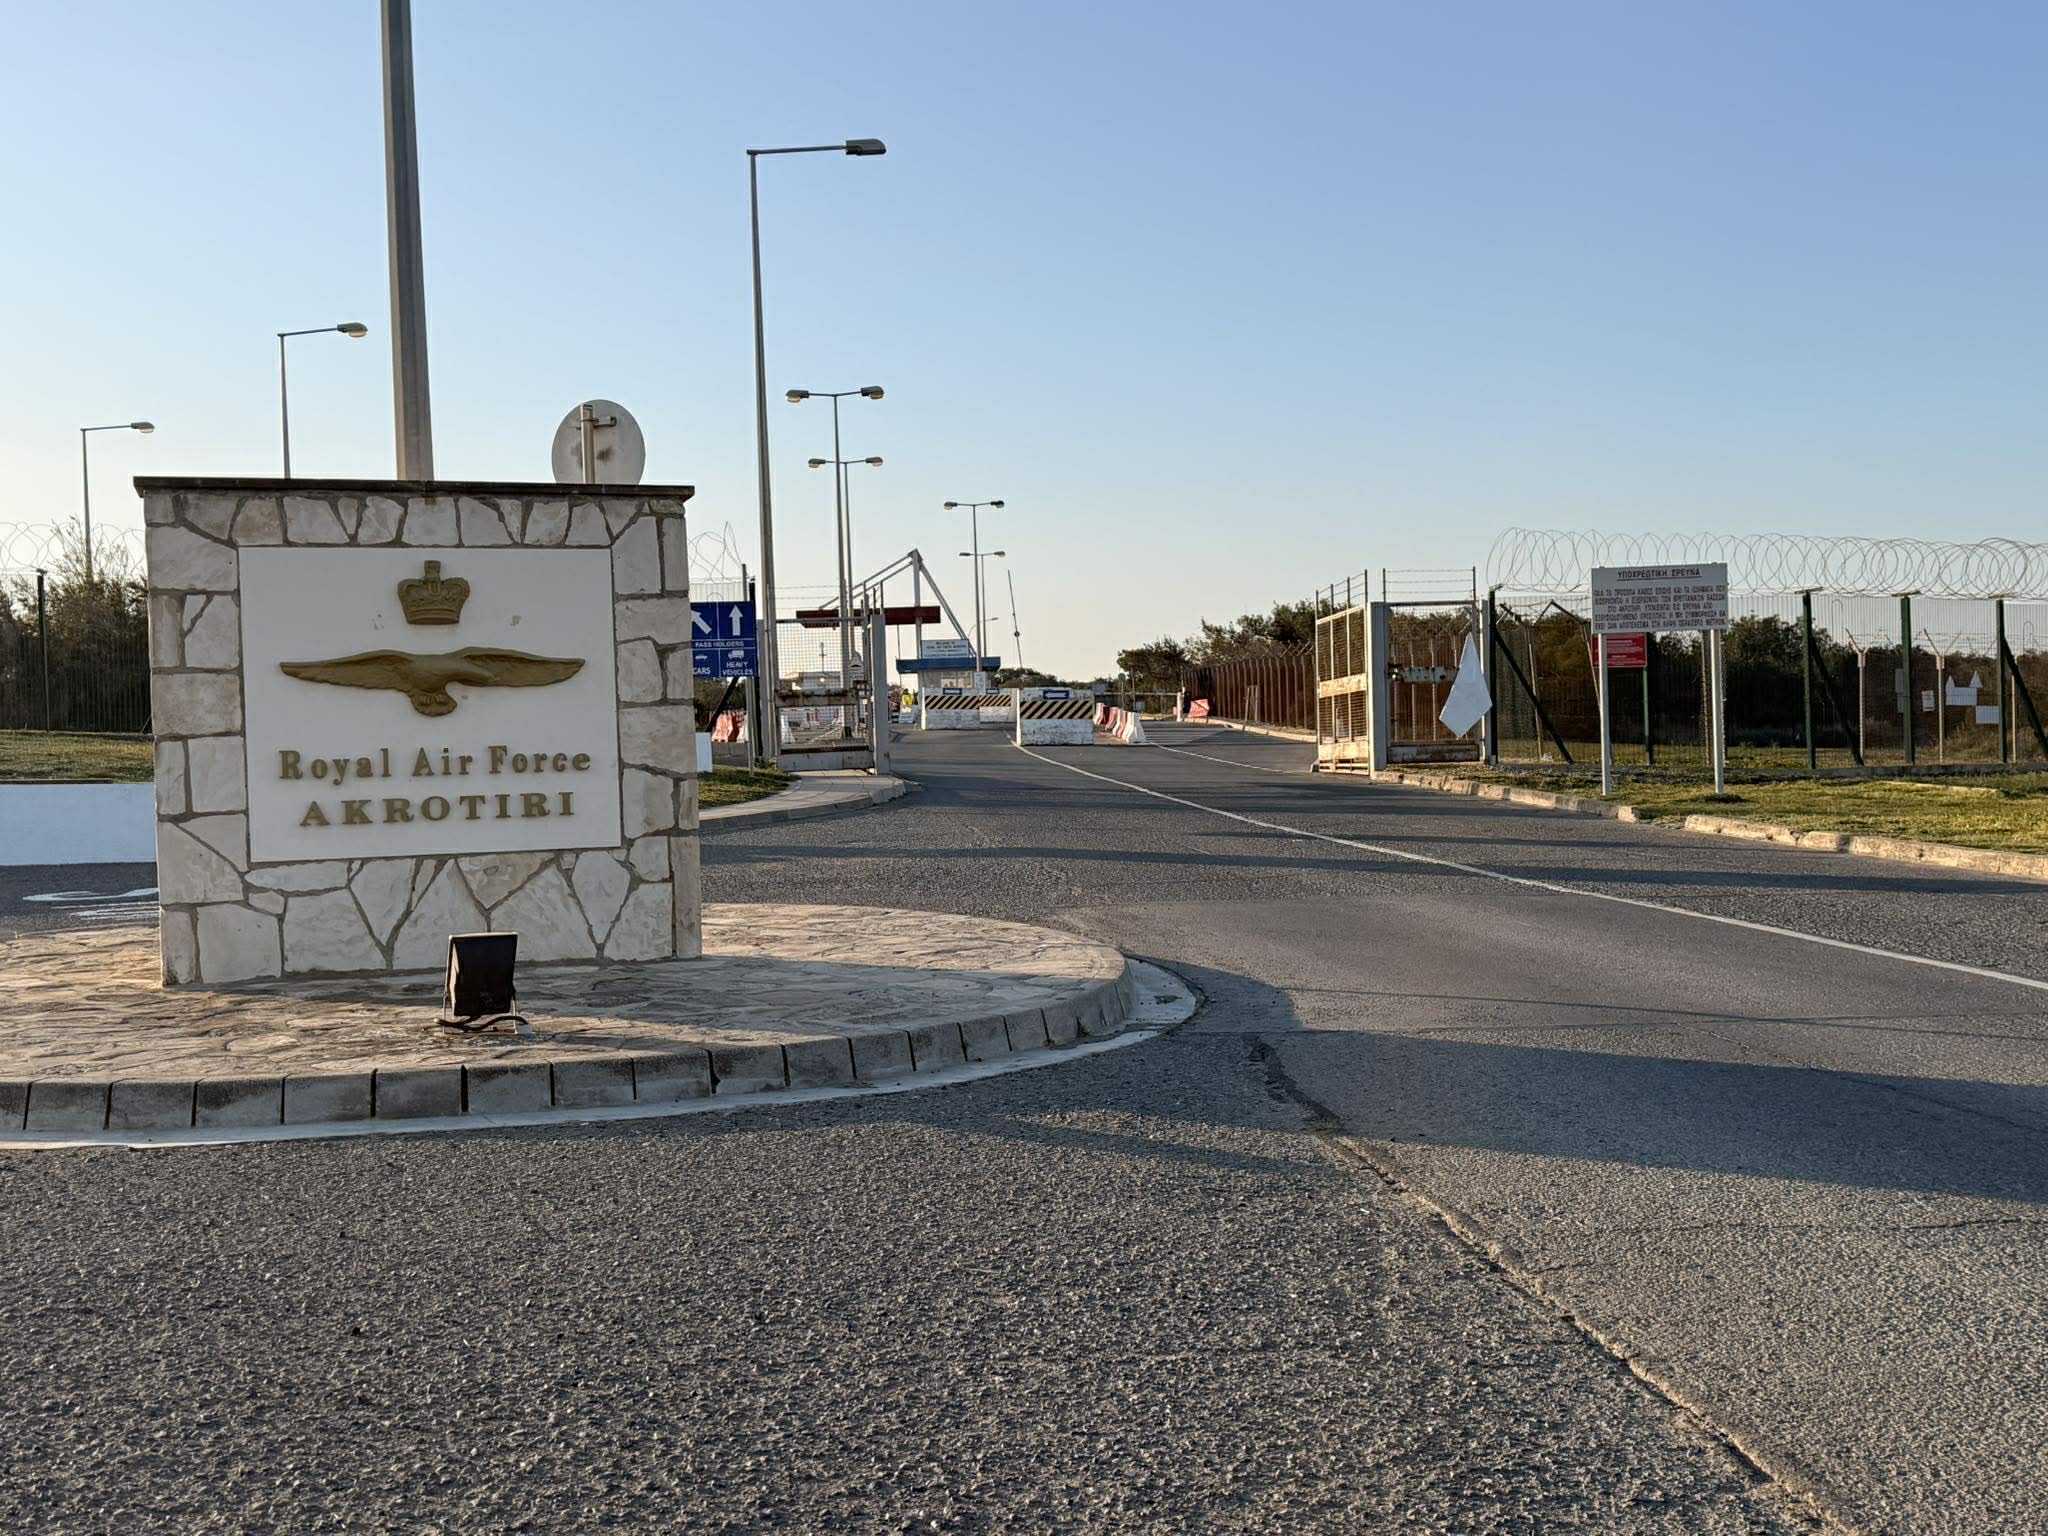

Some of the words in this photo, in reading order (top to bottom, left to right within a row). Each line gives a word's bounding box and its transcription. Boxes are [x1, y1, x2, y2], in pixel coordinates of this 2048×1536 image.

[1617, 569, 1667, 578] ΥΠΟΧΡΕΩΤΙΚΗ
[1672, 568, 1700, 577] ΕΡΕΥΝΑ
[692, 667, 711, 675] CARS
[278, 747, 392, 785] Royal
[411, 747, 473, 777] Air
[487, 745, 592, 774] Force
[299, 791, 575, 827] AKROTIRI
